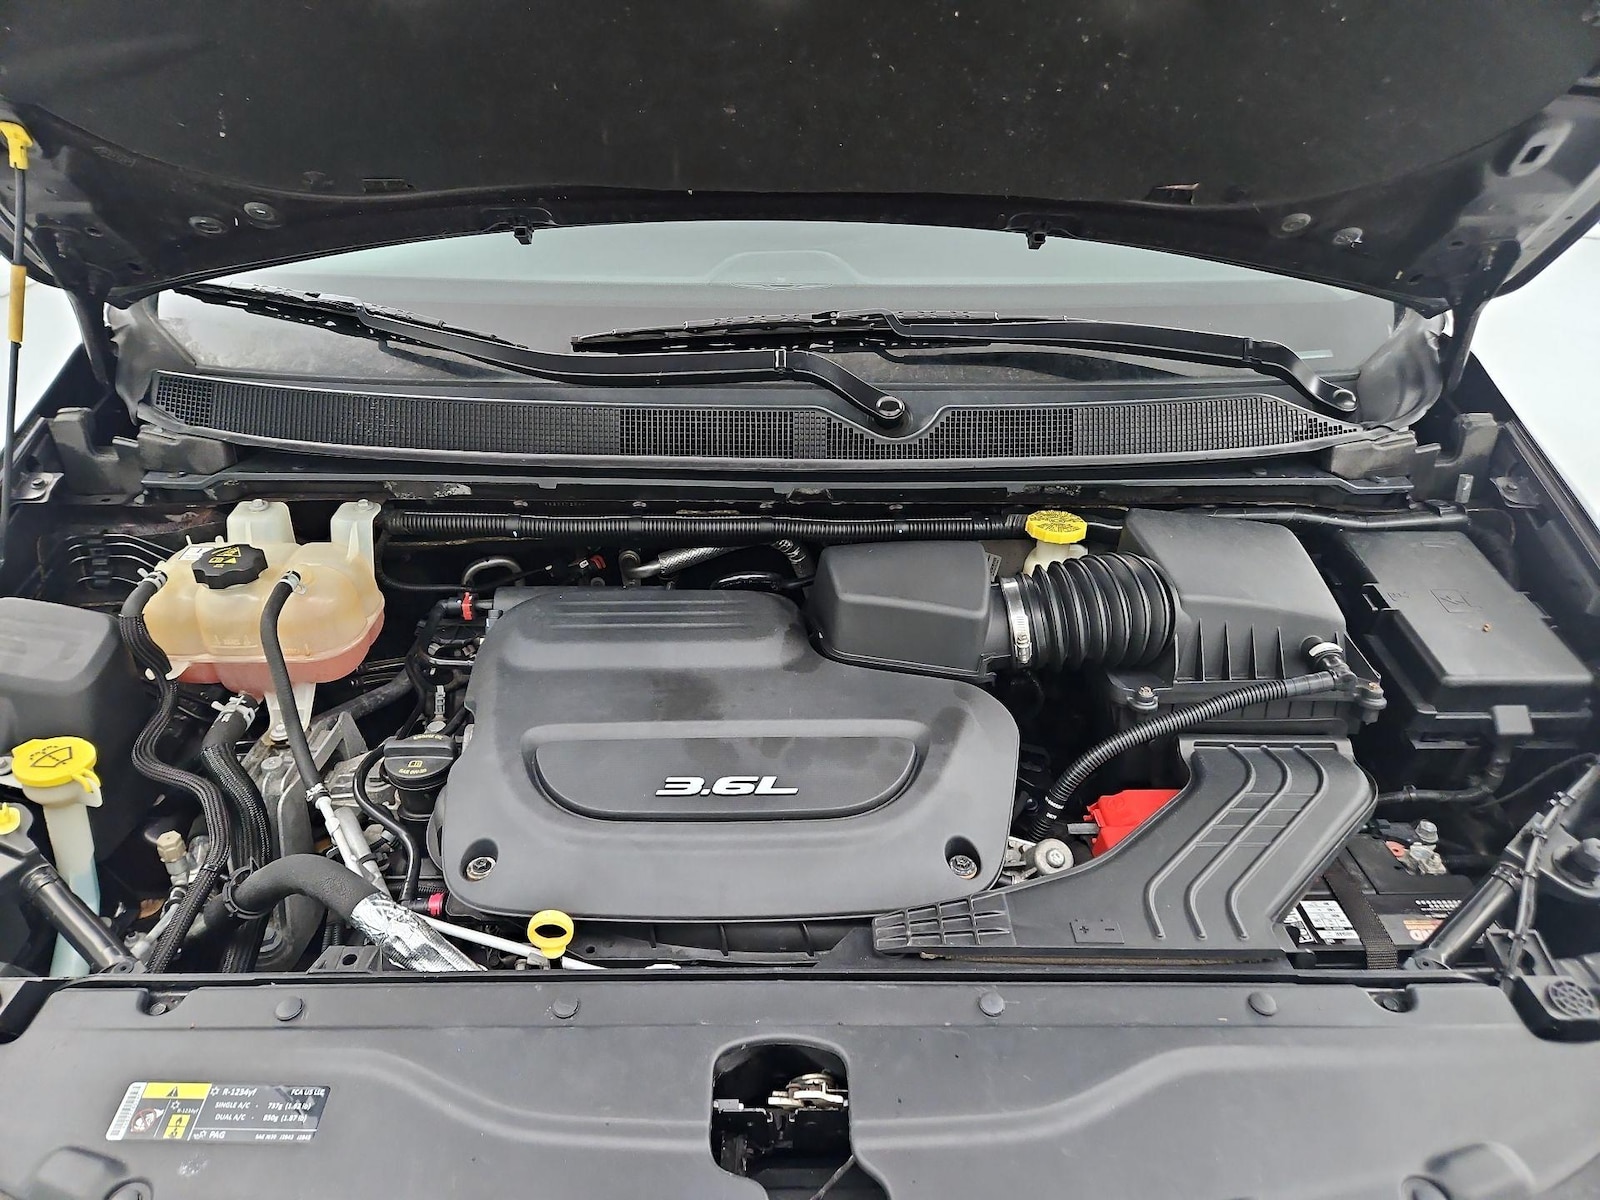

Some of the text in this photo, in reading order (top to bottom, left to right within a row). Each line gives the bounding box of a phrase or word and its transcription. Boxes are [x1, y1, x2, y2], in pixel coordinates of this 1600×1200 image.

[655, 776, 799, 796] 3.6L
[222, 1087, 258, 1098] R-1234yf
[290, 1088, 303, 1096] FCA
[303, 1088, 314, 1096] US
[214, 1101, 251, 1110] SINGLE A/C
[214, 1113, 247, 1122] DUAL A/C
[208, 1131, 226, 1139] PAG
